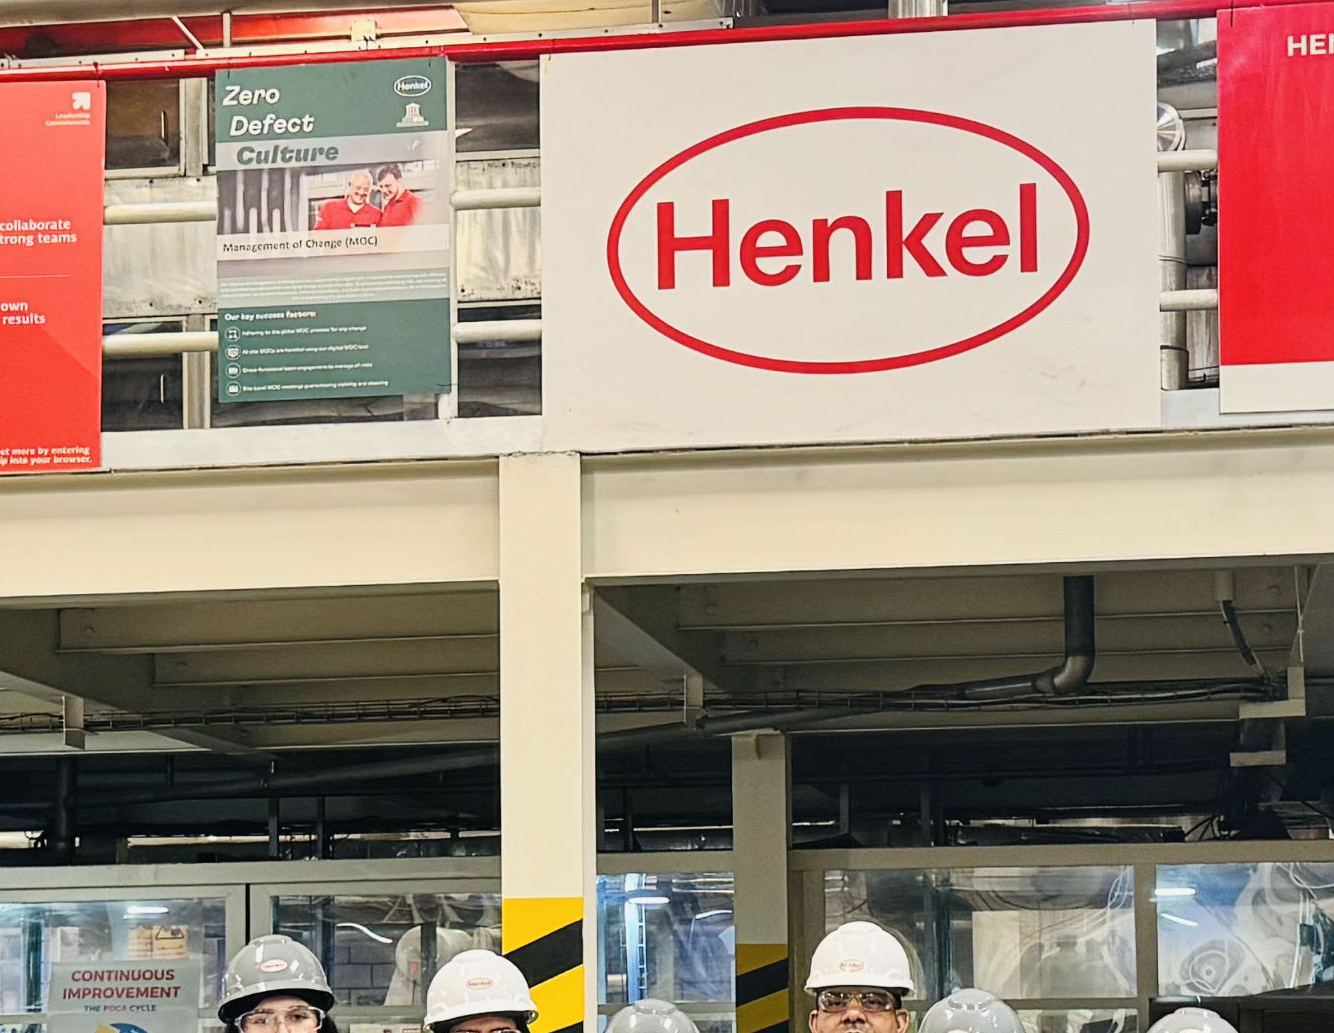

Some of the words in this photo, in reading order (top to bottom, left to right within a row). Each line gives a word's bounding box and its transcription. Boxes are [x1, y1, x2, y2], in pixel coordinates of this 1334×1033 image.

[397, 79, 428, 91] Henkel
[222, 85, 280, 106] Zero
[229, 114, 315, 136] Defect
[236, 144, 339, 165] Culture
[0, 219, 71, 231] collaborate
[38, 232, 77, 244] teams
[657, 183, 1038, 290] Henkel
[223, 242, 289, 253] Management
[292, 239, 303, 249] of
[305, 238, 342, 250] Change
[345, 236, 378, 247] (MOC)
[0, 301, 28, 312] own
[2, 313, 45, 325] results
[11, 447, 35, 455] more
[37, 446, 49, 456] by
[51, 446, 90, 456] entering
[9, 456, 28, 464] into
[29, 456, 51, 465] your
[53, 455, 92, 464] browser.
[71, 969, 175, 982] CONTINUOUS
[63, 986, 181, 999] IMPROVEMENT
[129, 1004, 157, 1012] CYCLE
